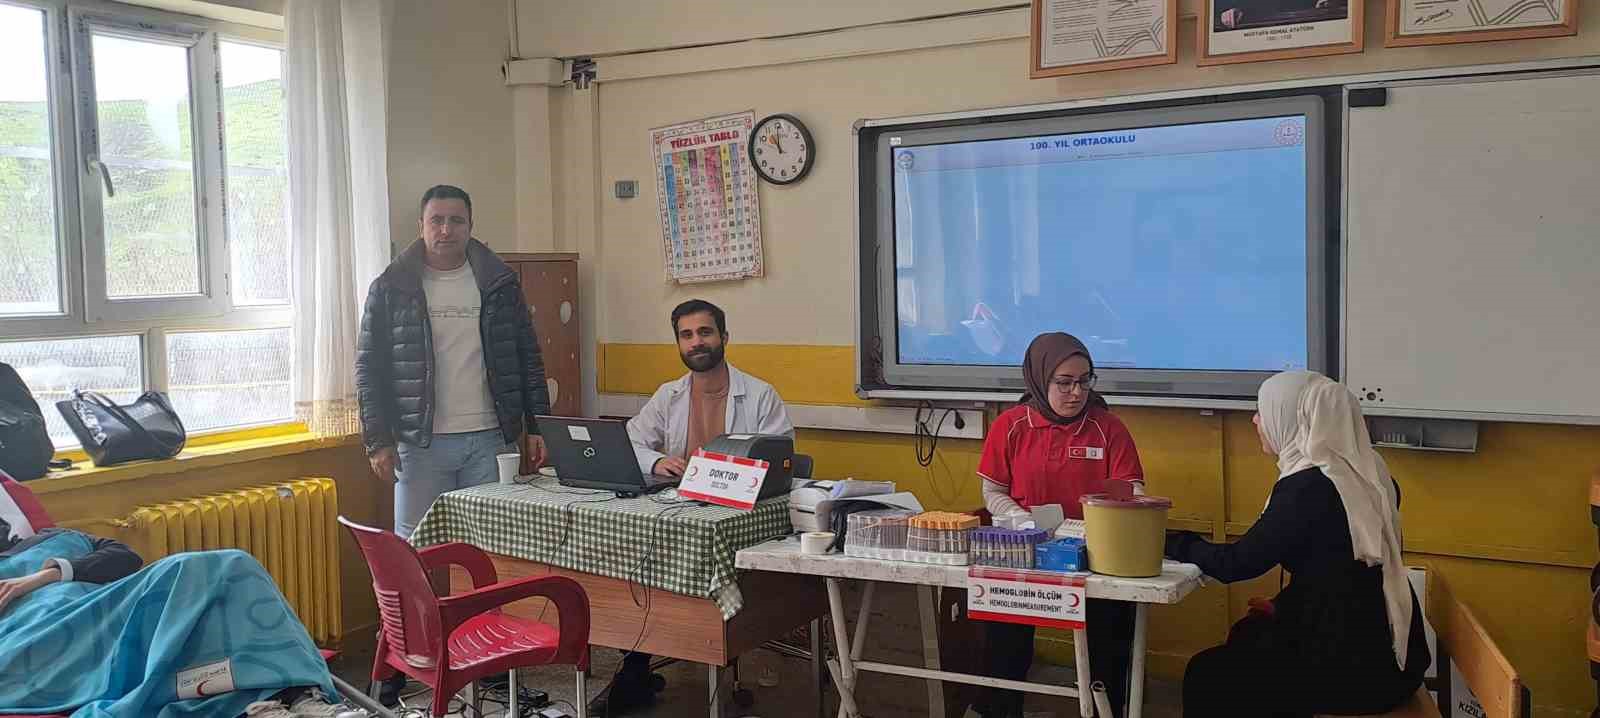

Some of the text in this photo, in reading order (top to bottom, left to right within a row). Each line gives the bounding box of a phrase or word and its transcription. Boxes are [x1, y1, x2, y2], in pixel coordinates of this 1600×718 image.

[709, 130, 739, 143] TABLO
[1030, 135, 1136, 150] 100. YIL ORTAOKULU
[792, 165, 797, 173] 5
[709, 468, 739, 481] DOKTOR
[989, 586, 1062, 600] HEMOGLOBİN ÖLÇÜM
